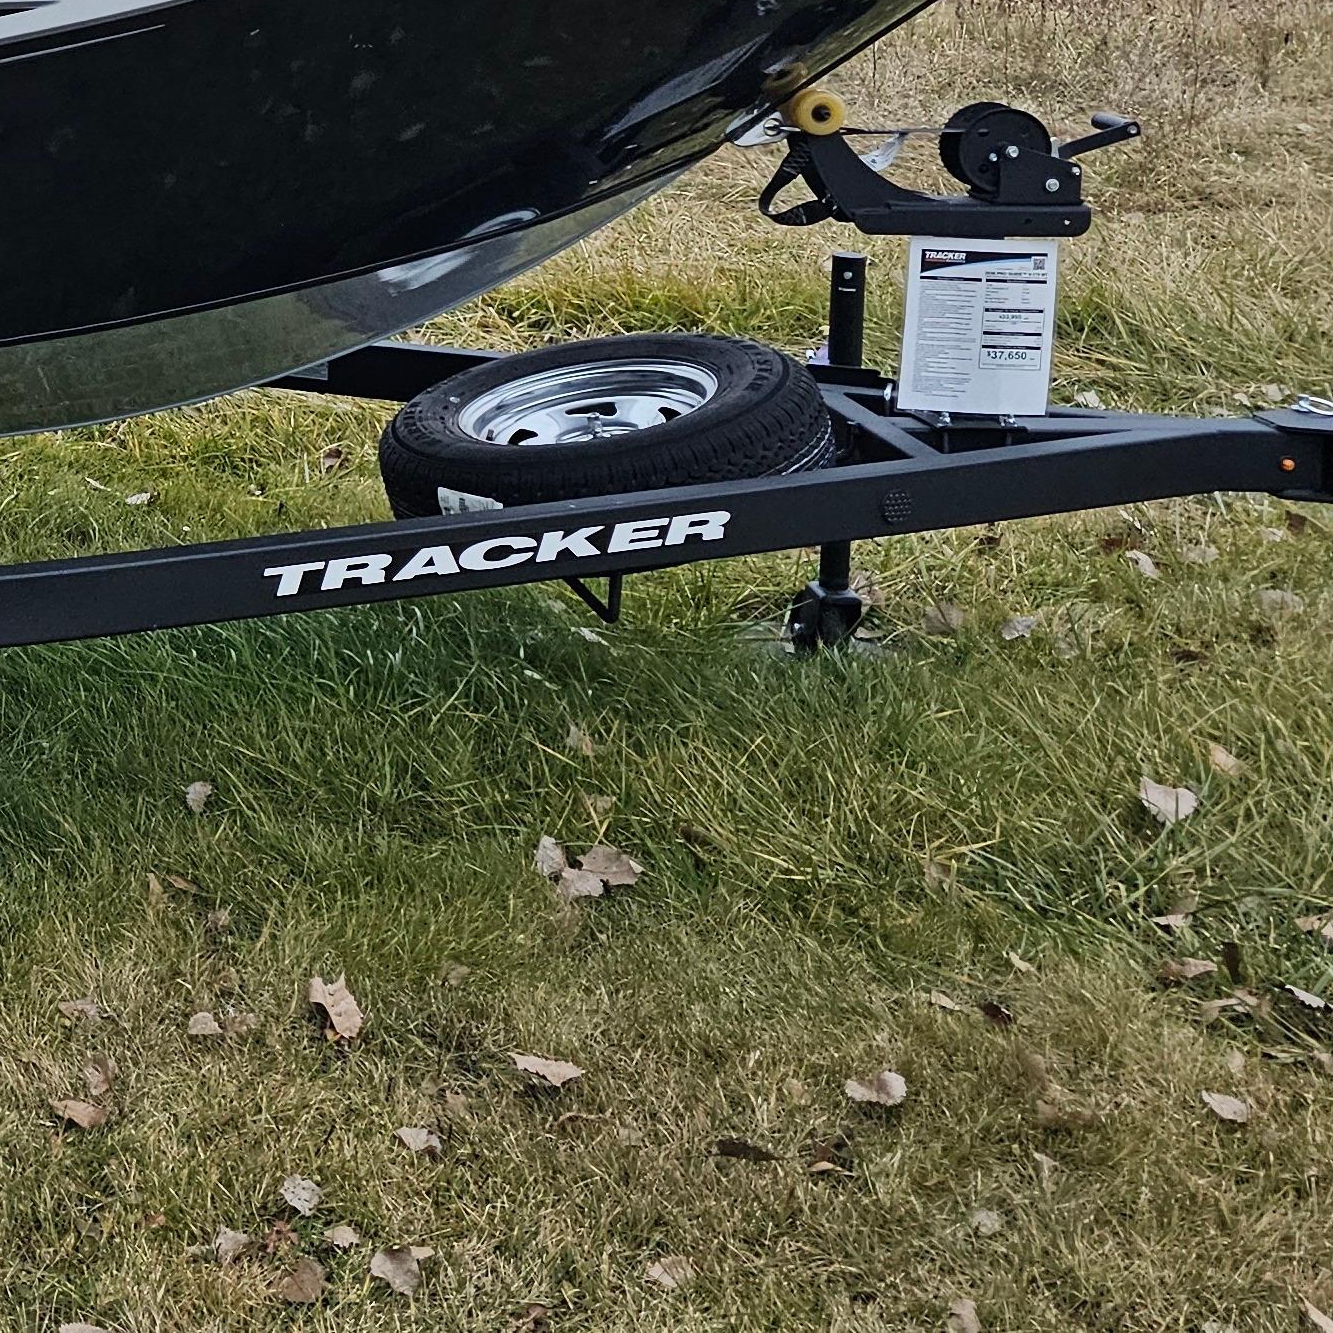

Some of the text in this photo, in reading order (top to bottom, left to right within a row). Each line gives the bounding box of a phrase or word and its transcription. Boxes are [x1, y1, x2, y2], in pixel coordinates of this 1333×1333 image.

[924, 251, 967, 260] TRACKER
[986, 350, 1027, 361] $37,650
[263, 510, 732, 598] TRACKER
